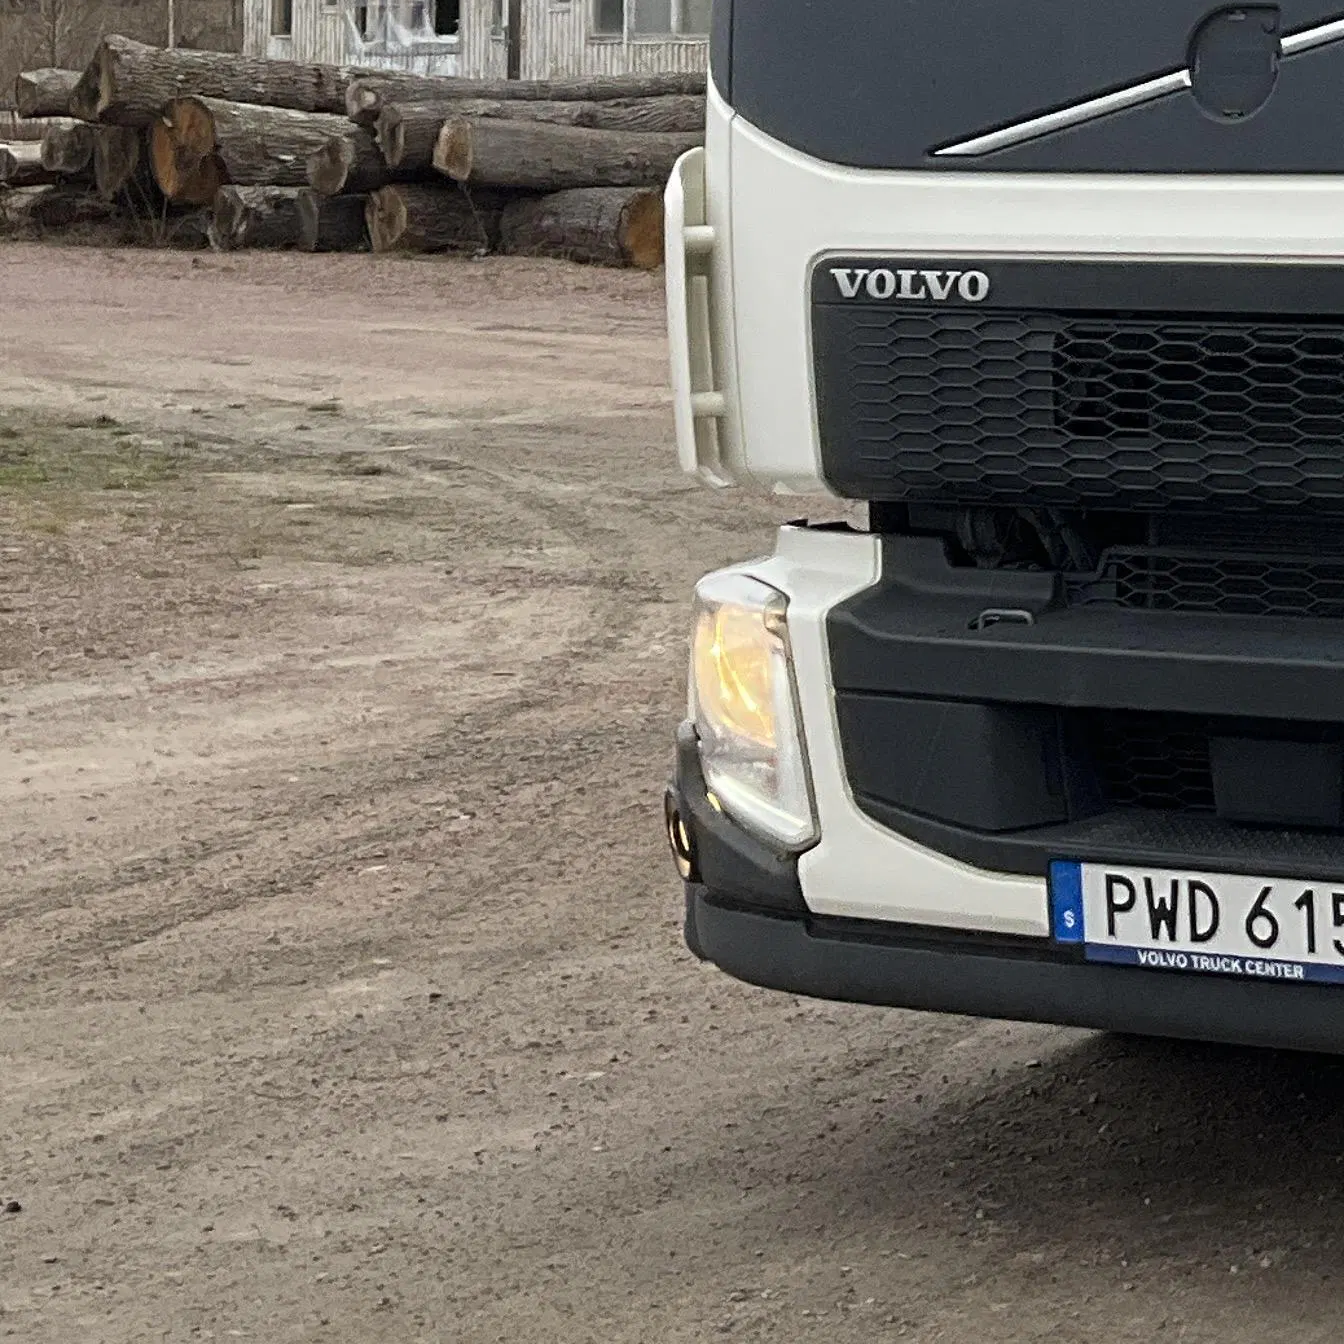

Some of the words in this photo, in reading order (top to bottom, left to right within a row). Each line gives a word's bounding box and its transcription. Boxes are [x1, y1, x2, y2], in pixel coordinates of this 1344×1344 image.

[829, 268, 990, 302] VOLVO
[1063, 909, 1075, 929] S
[1105, 872, 1220, 943] PWD
[1136, 949, 1188, 969] VOLVO
[1190, 954, 1243, 974] TRUCK
[1245, 960, 1305, 979] CENTER
